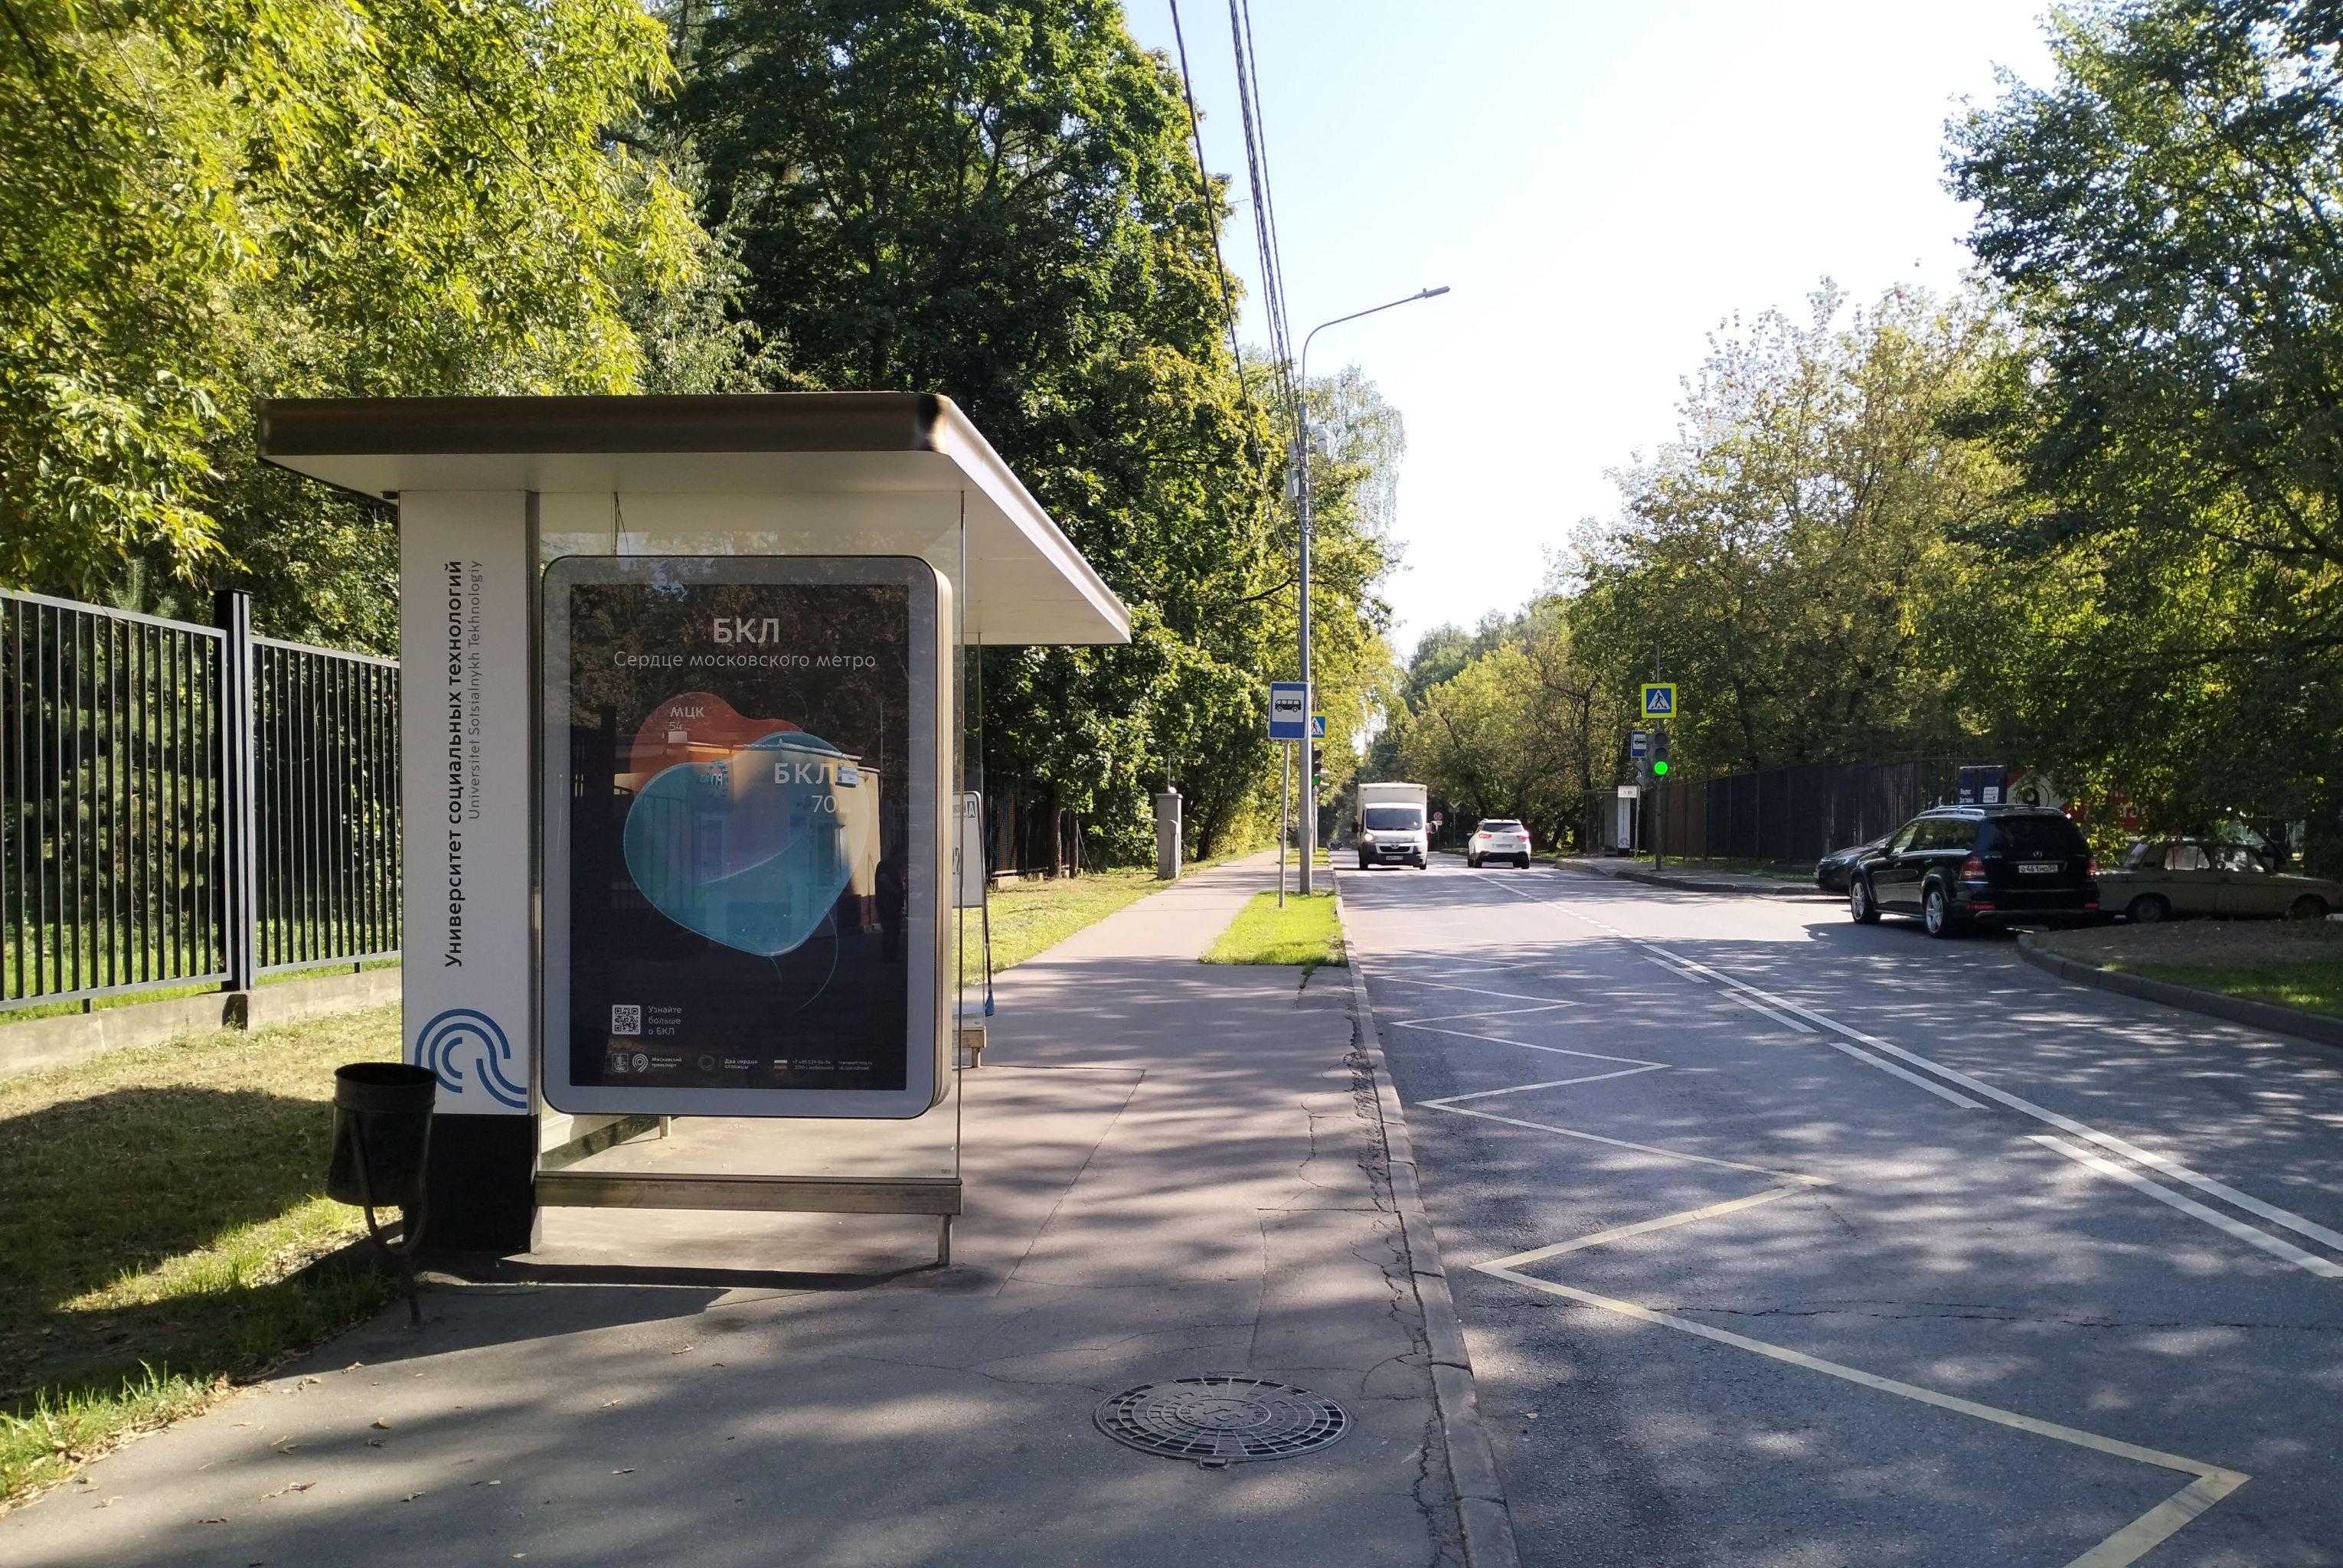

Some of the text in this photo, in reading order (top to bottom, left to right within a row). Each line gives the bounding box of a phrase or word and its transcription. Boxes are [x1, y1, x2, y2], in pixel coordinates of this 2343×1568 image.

[713, 618, 780, 643] БКЛ
[613, 651, 877, 669] Сердце московского метро
[468, 560, 482, 820] Universitet Sotsialnykh Tekhnologiy
[669, 706, 704, 719] МЦК
[443, 560, 465, 968] Университет социальных технологий
[774, 763, 835, 785] БКЛ
[811, 795, 837, 813] 70
[648, 1005, 683, 1014] Узнайте
[648, 1017, 681, 1025] больше
